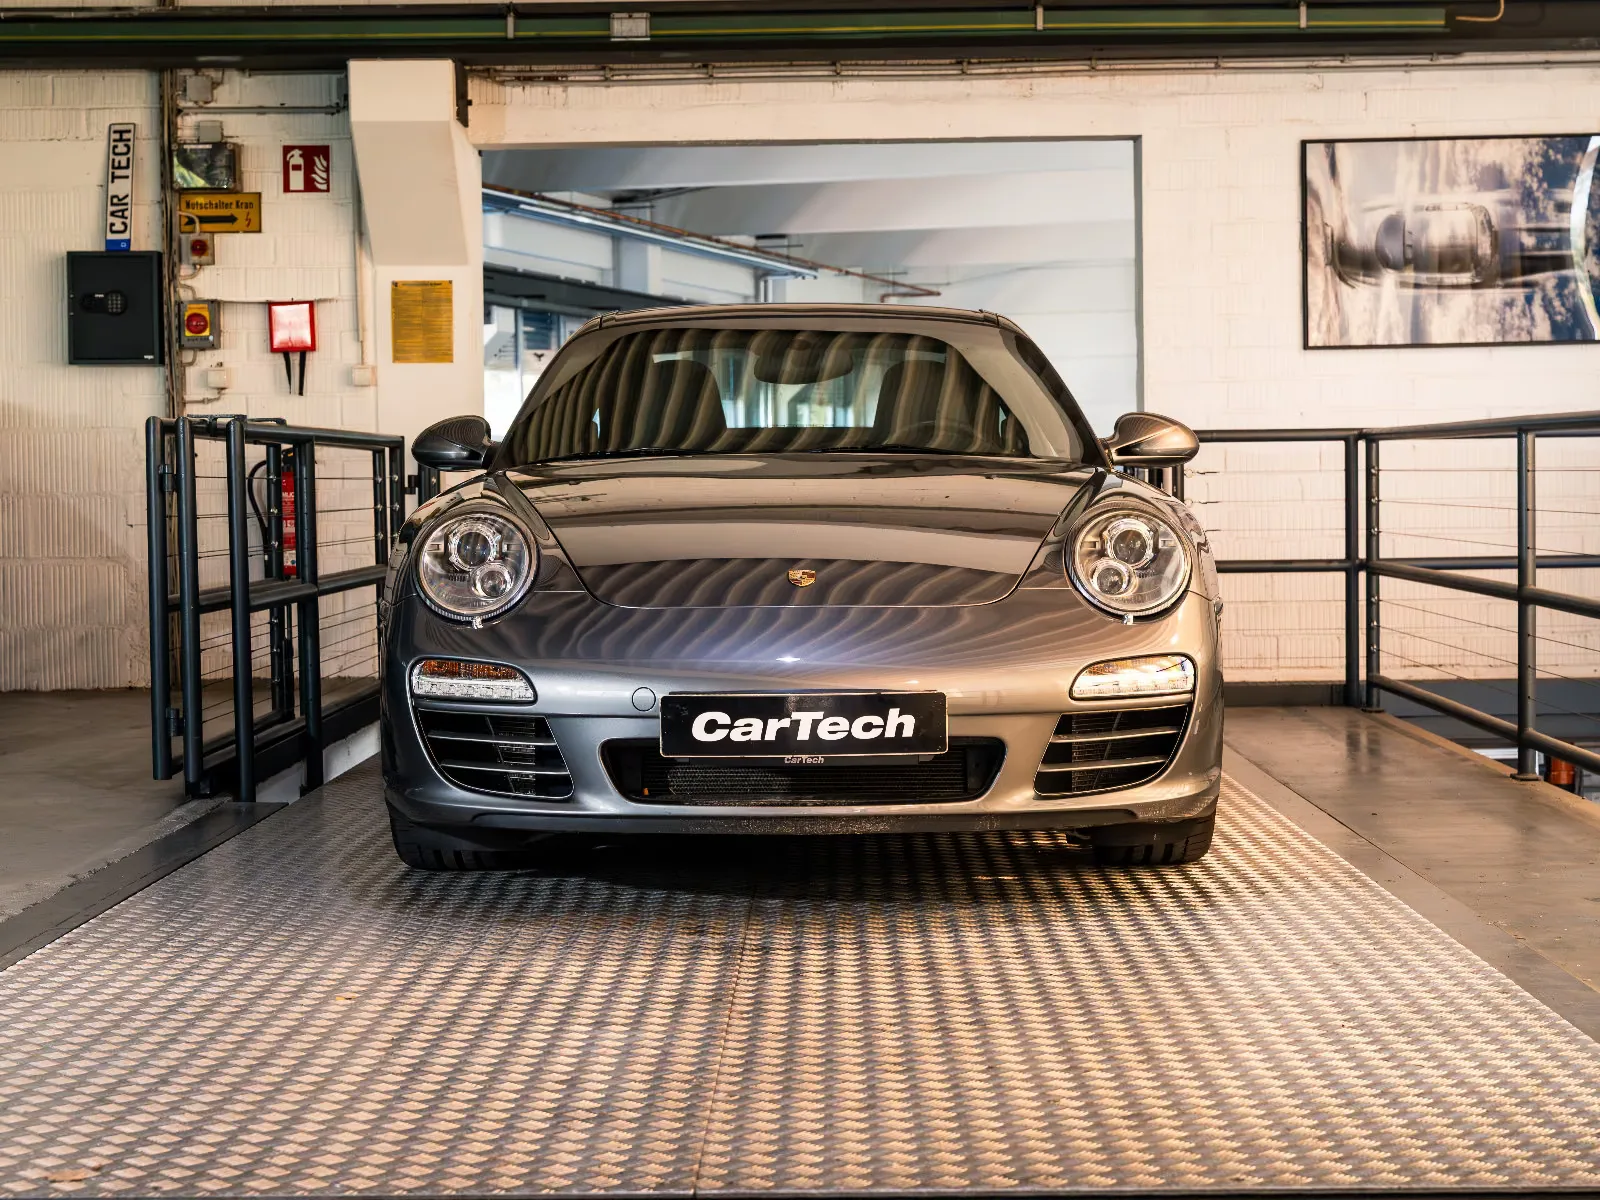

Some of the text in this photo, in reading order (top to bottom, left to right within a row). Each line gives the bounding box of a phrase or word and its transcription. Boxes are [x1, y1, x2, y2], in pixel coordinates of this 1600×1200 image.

[109, 129, 132, 234] CAR TECH
[185, 200, 254, 210] Notschalter Kran
[691, 708, 916, 742] CarTech
[784, 756, 825, 764] CarTech
